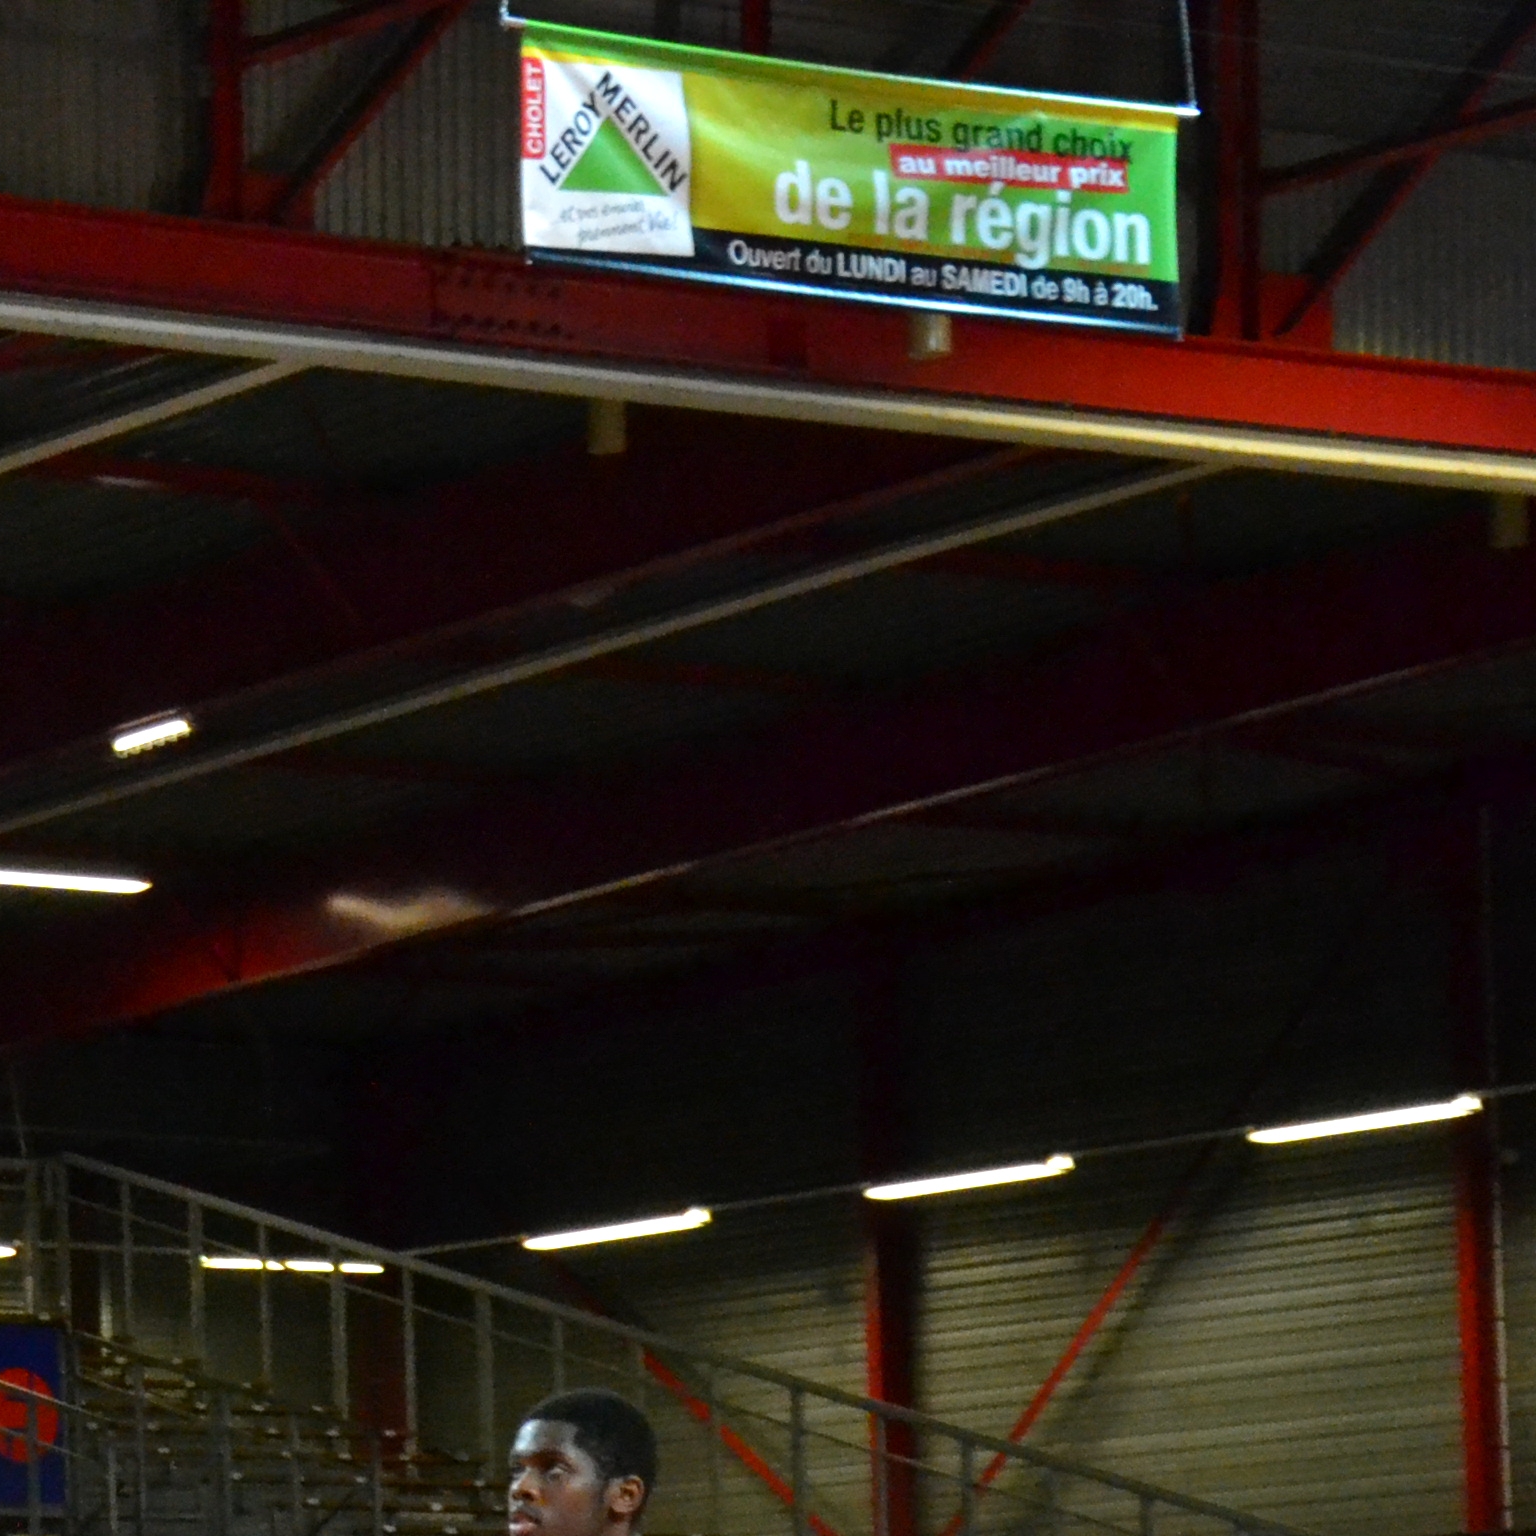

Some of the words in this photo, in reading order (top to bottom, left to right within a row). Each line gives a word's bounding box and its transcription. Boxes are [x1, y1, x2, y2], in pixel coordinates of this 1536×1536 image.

[526, 62, 544, 155] CHOLET
[539, 91, 601, 186] LEROY
[596, 71, 689, 193] MERLIN
[830, 99, 865, 133] Le
[875, 107, 943, 142] plus
[951, 119, 1043, 151] grand
[1053, 128, 1133, 164] choix
[898, 156, 936, 175] au
[944, 155, 1063, 183] meilleur
[1067, 161, 1126, 189] prix
[774, 159, 854, 231] de
[872, 169, 929, 241] la
[950, 180, 1151, 270] région
[727, 239, 801, 272] Ouvert
[806, 248, 832, 275] du
[836, 252, 907, 284] LUNDI
[910, 265, 937, 288] au
[940, 264, 1028, 298] SAMEDI
[1031, 274, 1060, 301] de
[1061, 277, 1090, 305] 9h
